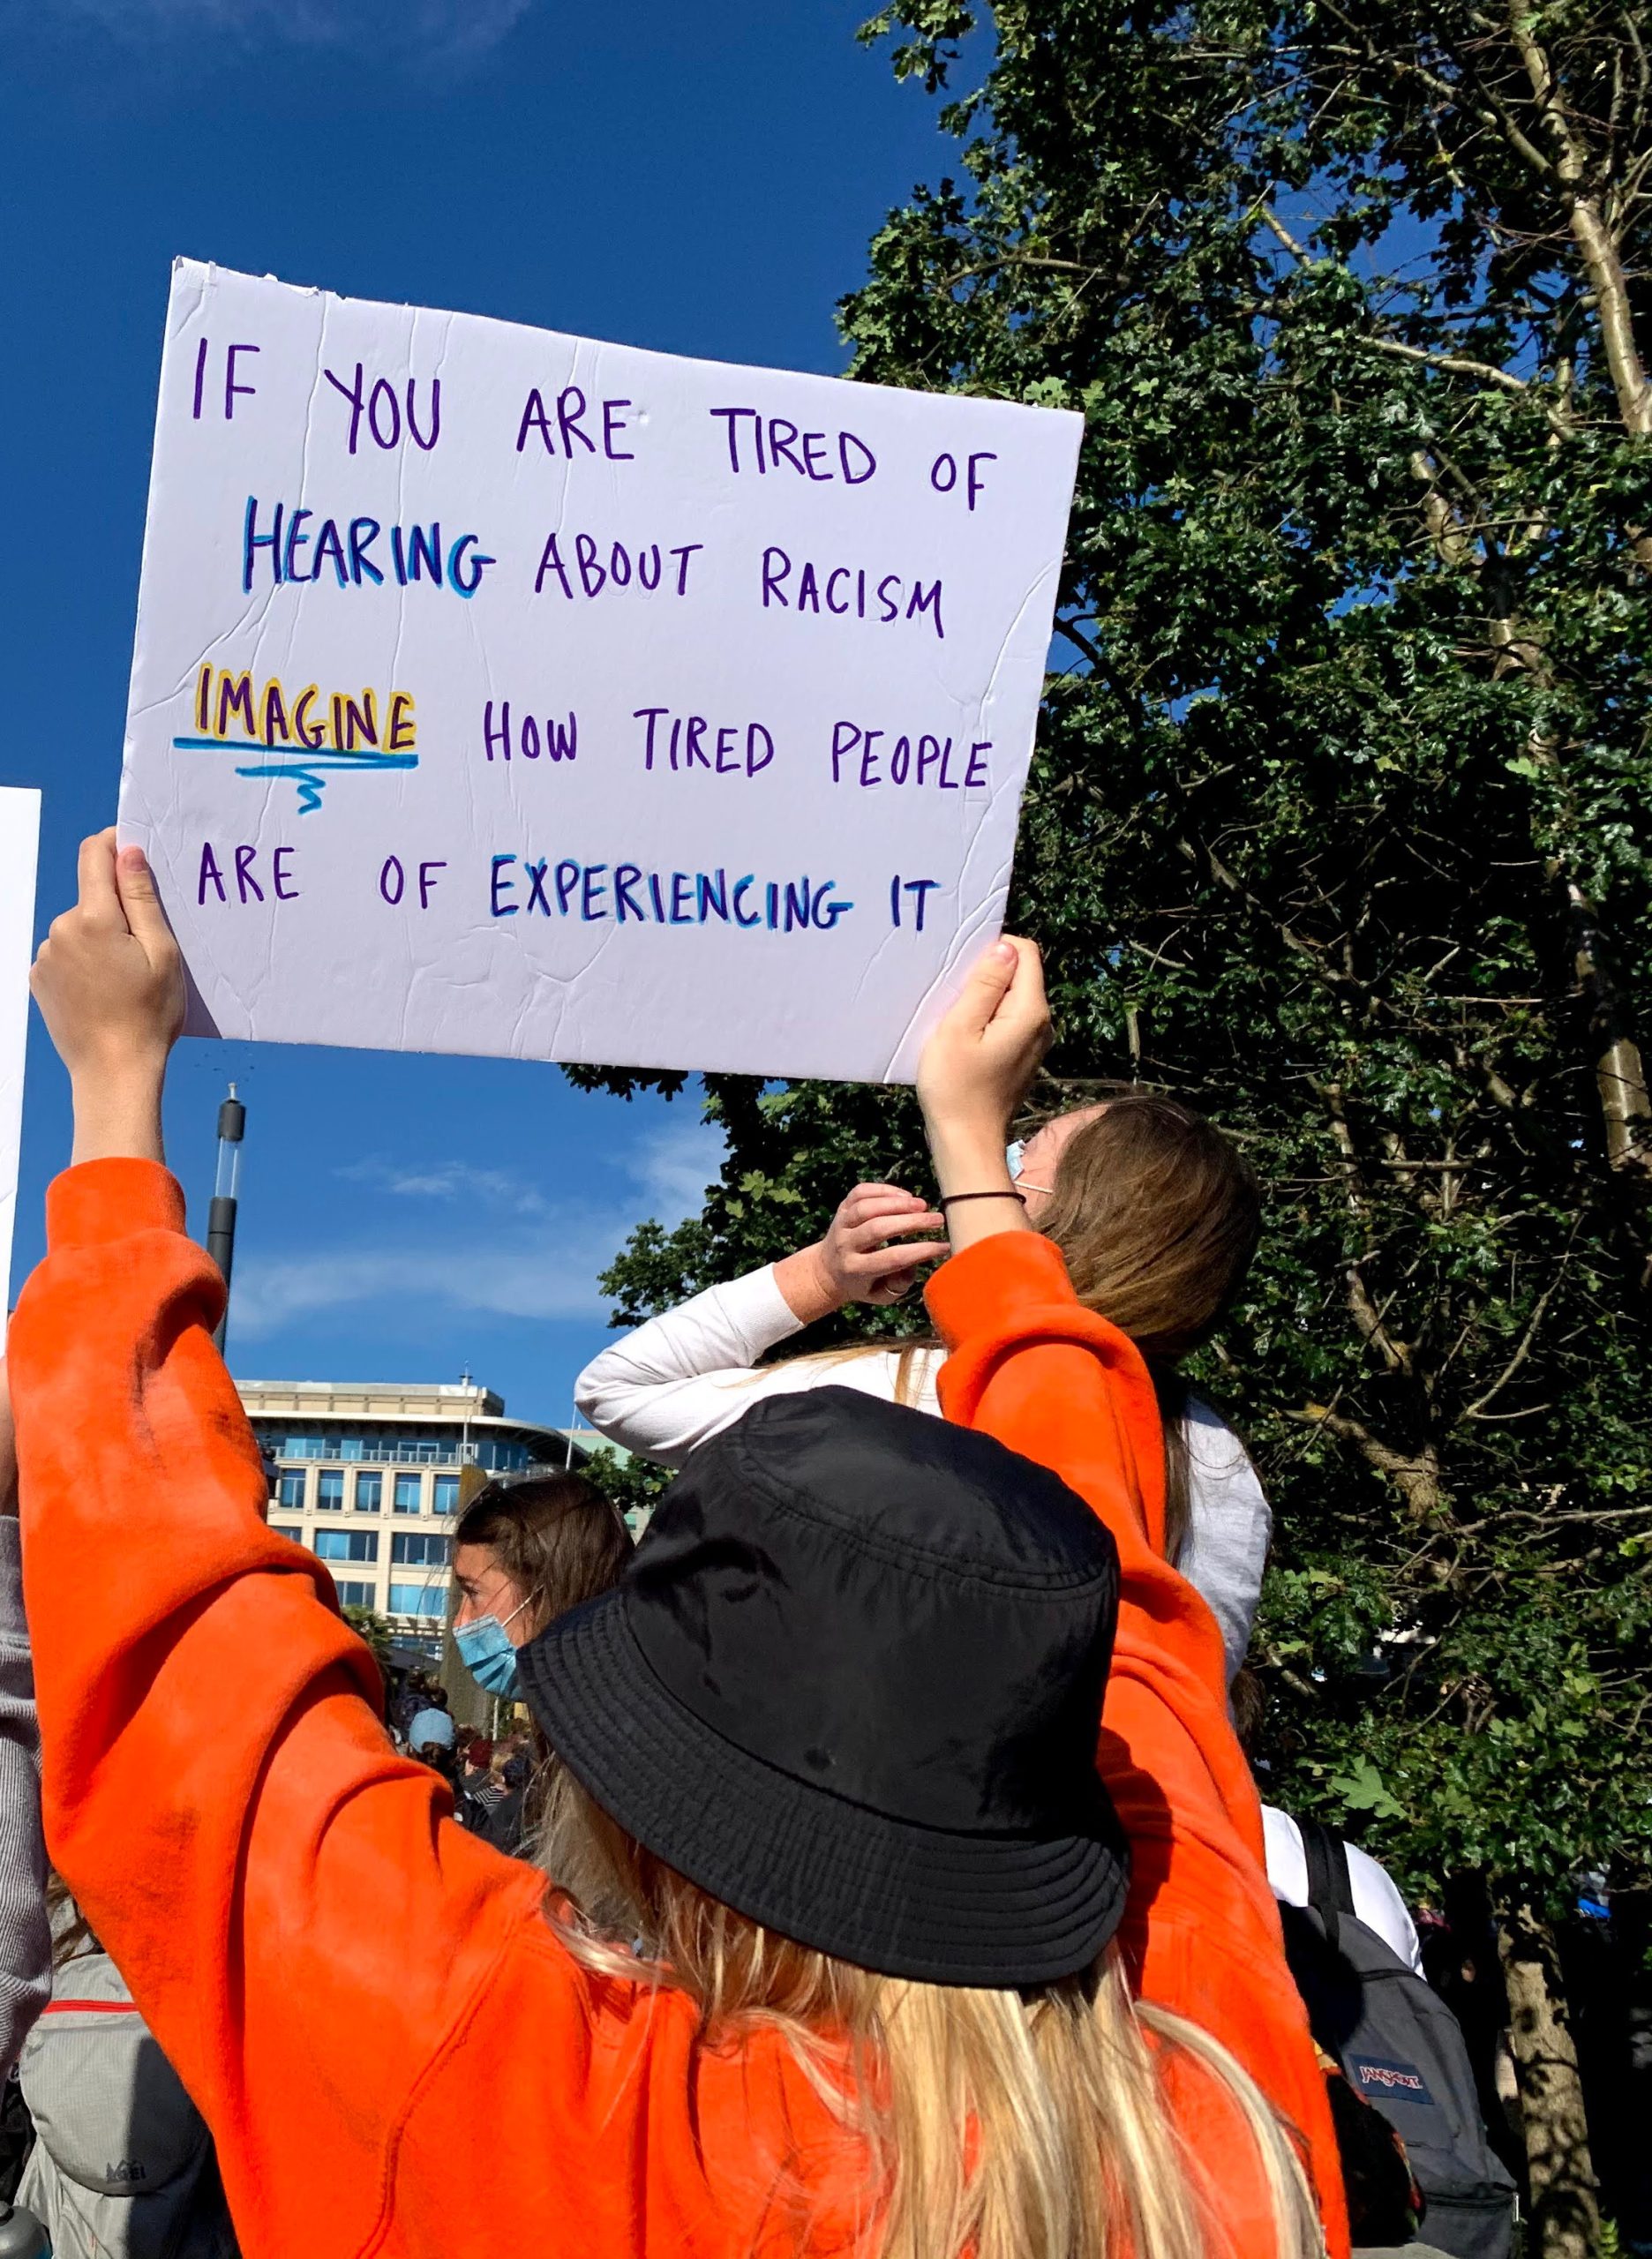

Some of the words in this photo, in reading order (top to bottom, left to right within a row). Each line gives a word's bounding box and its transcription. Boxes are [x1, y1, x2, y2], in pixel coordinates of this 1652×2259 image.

[193, 338, 259, 419] IF
[324, 363, 439, 454] YOU
[517, 387, 634, 459] ARE
[710, 409, 876, 484] TIRED
[931, 453, 997, 511] OF
[243, 496, 496, 599] HEARING
[535, 533, 703, 599] ABOUT
[762, 547, 943, 638] RACISM
[195, 664, 417, 751] IMAGINE
[484, 701, 576, 762] HOW
[634, 709, 774, 777] TIRED
[832, 722, 992, 788] PEOPLE
[199, 843, 299, 904] ARE
[380, 855, 447, 909] OF
[491, 854, 854, 932] EXPERIENCING
[891, 875, 940, 931] IT
